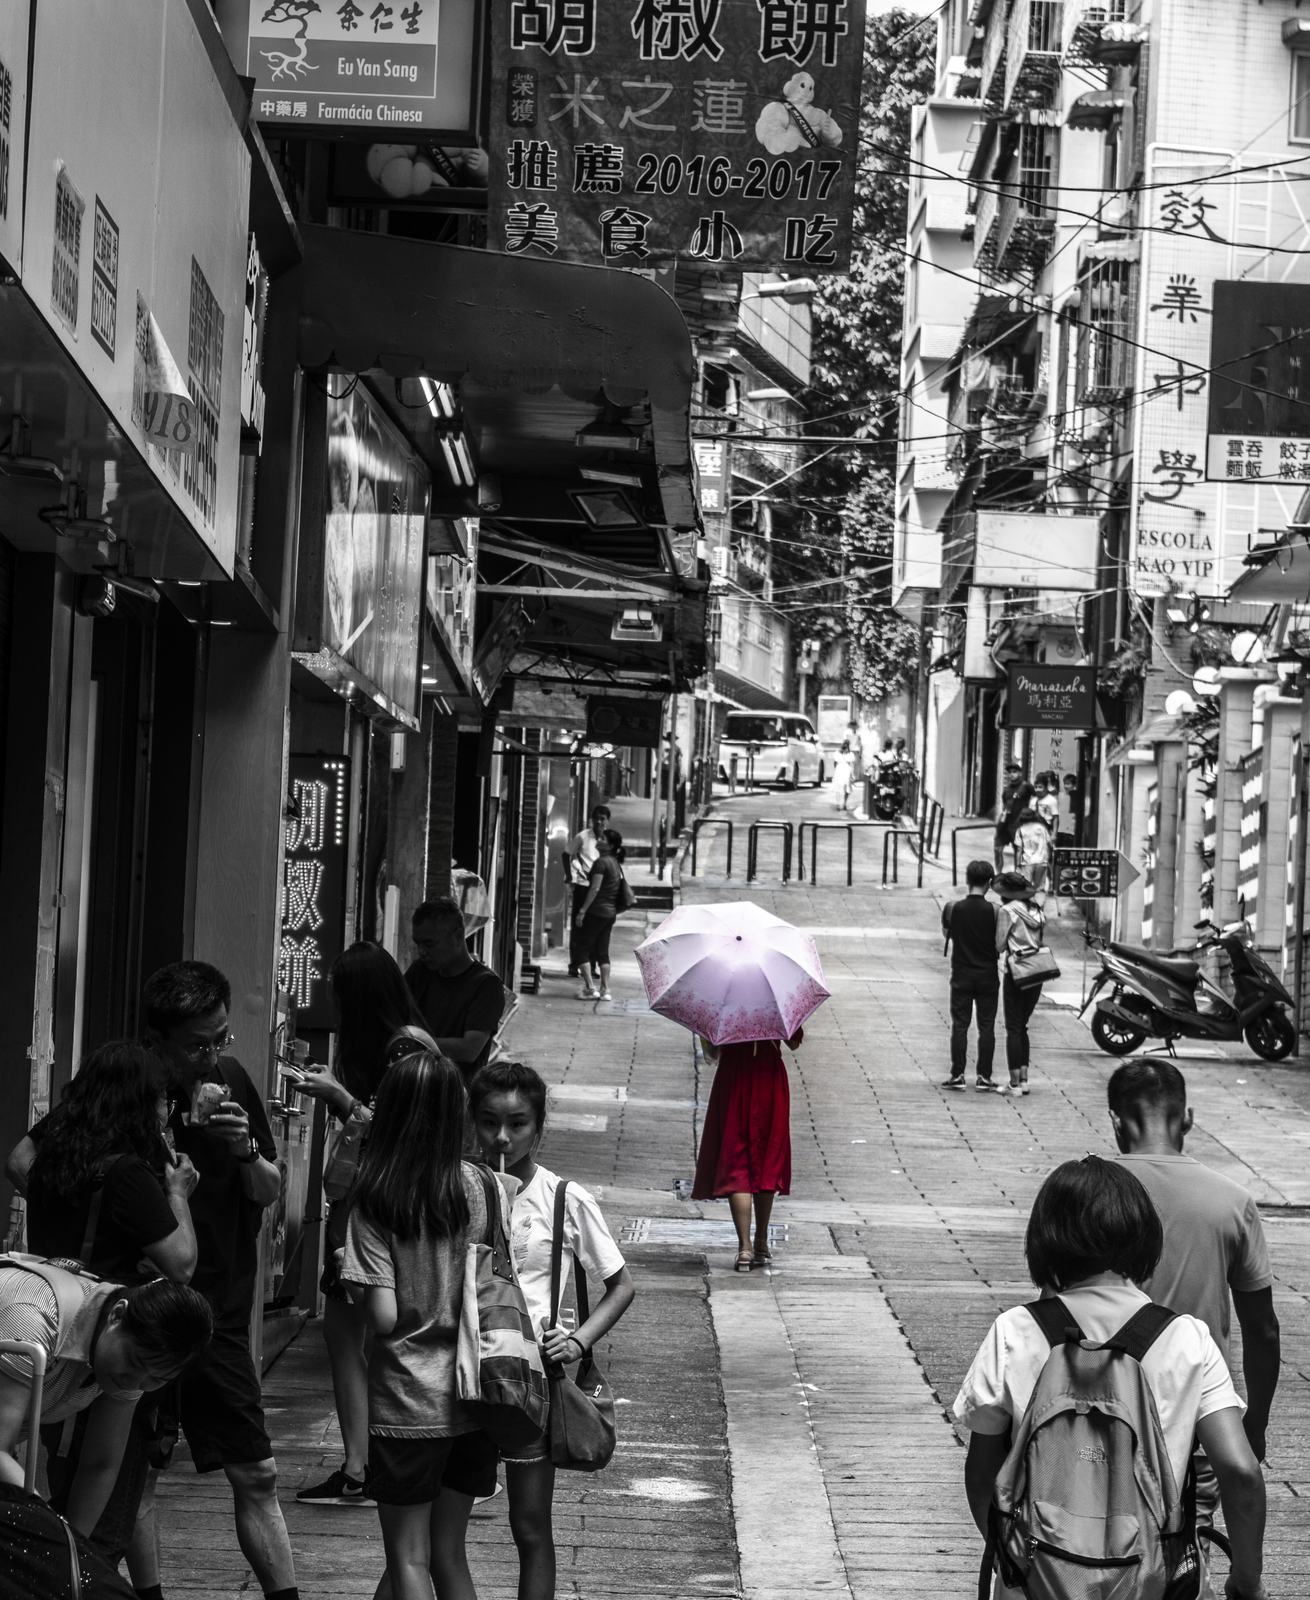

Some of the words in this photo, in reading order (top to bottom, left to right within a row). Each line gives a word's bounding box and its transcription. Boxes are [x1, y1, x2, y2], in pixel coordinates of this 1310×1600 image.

[336, 1, 423, 34] 余仁生
[510, 0, 849, 66] 胡椒餅
[337, 57, 354, 75] Eu
[356, 58, 381, 77] Yan
[383, 60, 418, 82] Sang
[260, 100, 308, 118] 中藥房
[318, 102, 373, 121] Farmácia
[376, 104, 423, 123] Chinesa
[511, 73, 536, 123] 榮獲
[548, 73, 748, 134] 米之蓮
[505, 139, 624, 195] 推薦
[634, 153, 842, 200] 2016-2017
[505, 201, 839, 265] 美食小吃
[1137, 529, 1213, 551] ESCOLA
[1137, 556, 1176, 575] KAO
[1182, 560, 1213, 577] YIP
[1027, 693, 1073, 709] 瑪利亞
